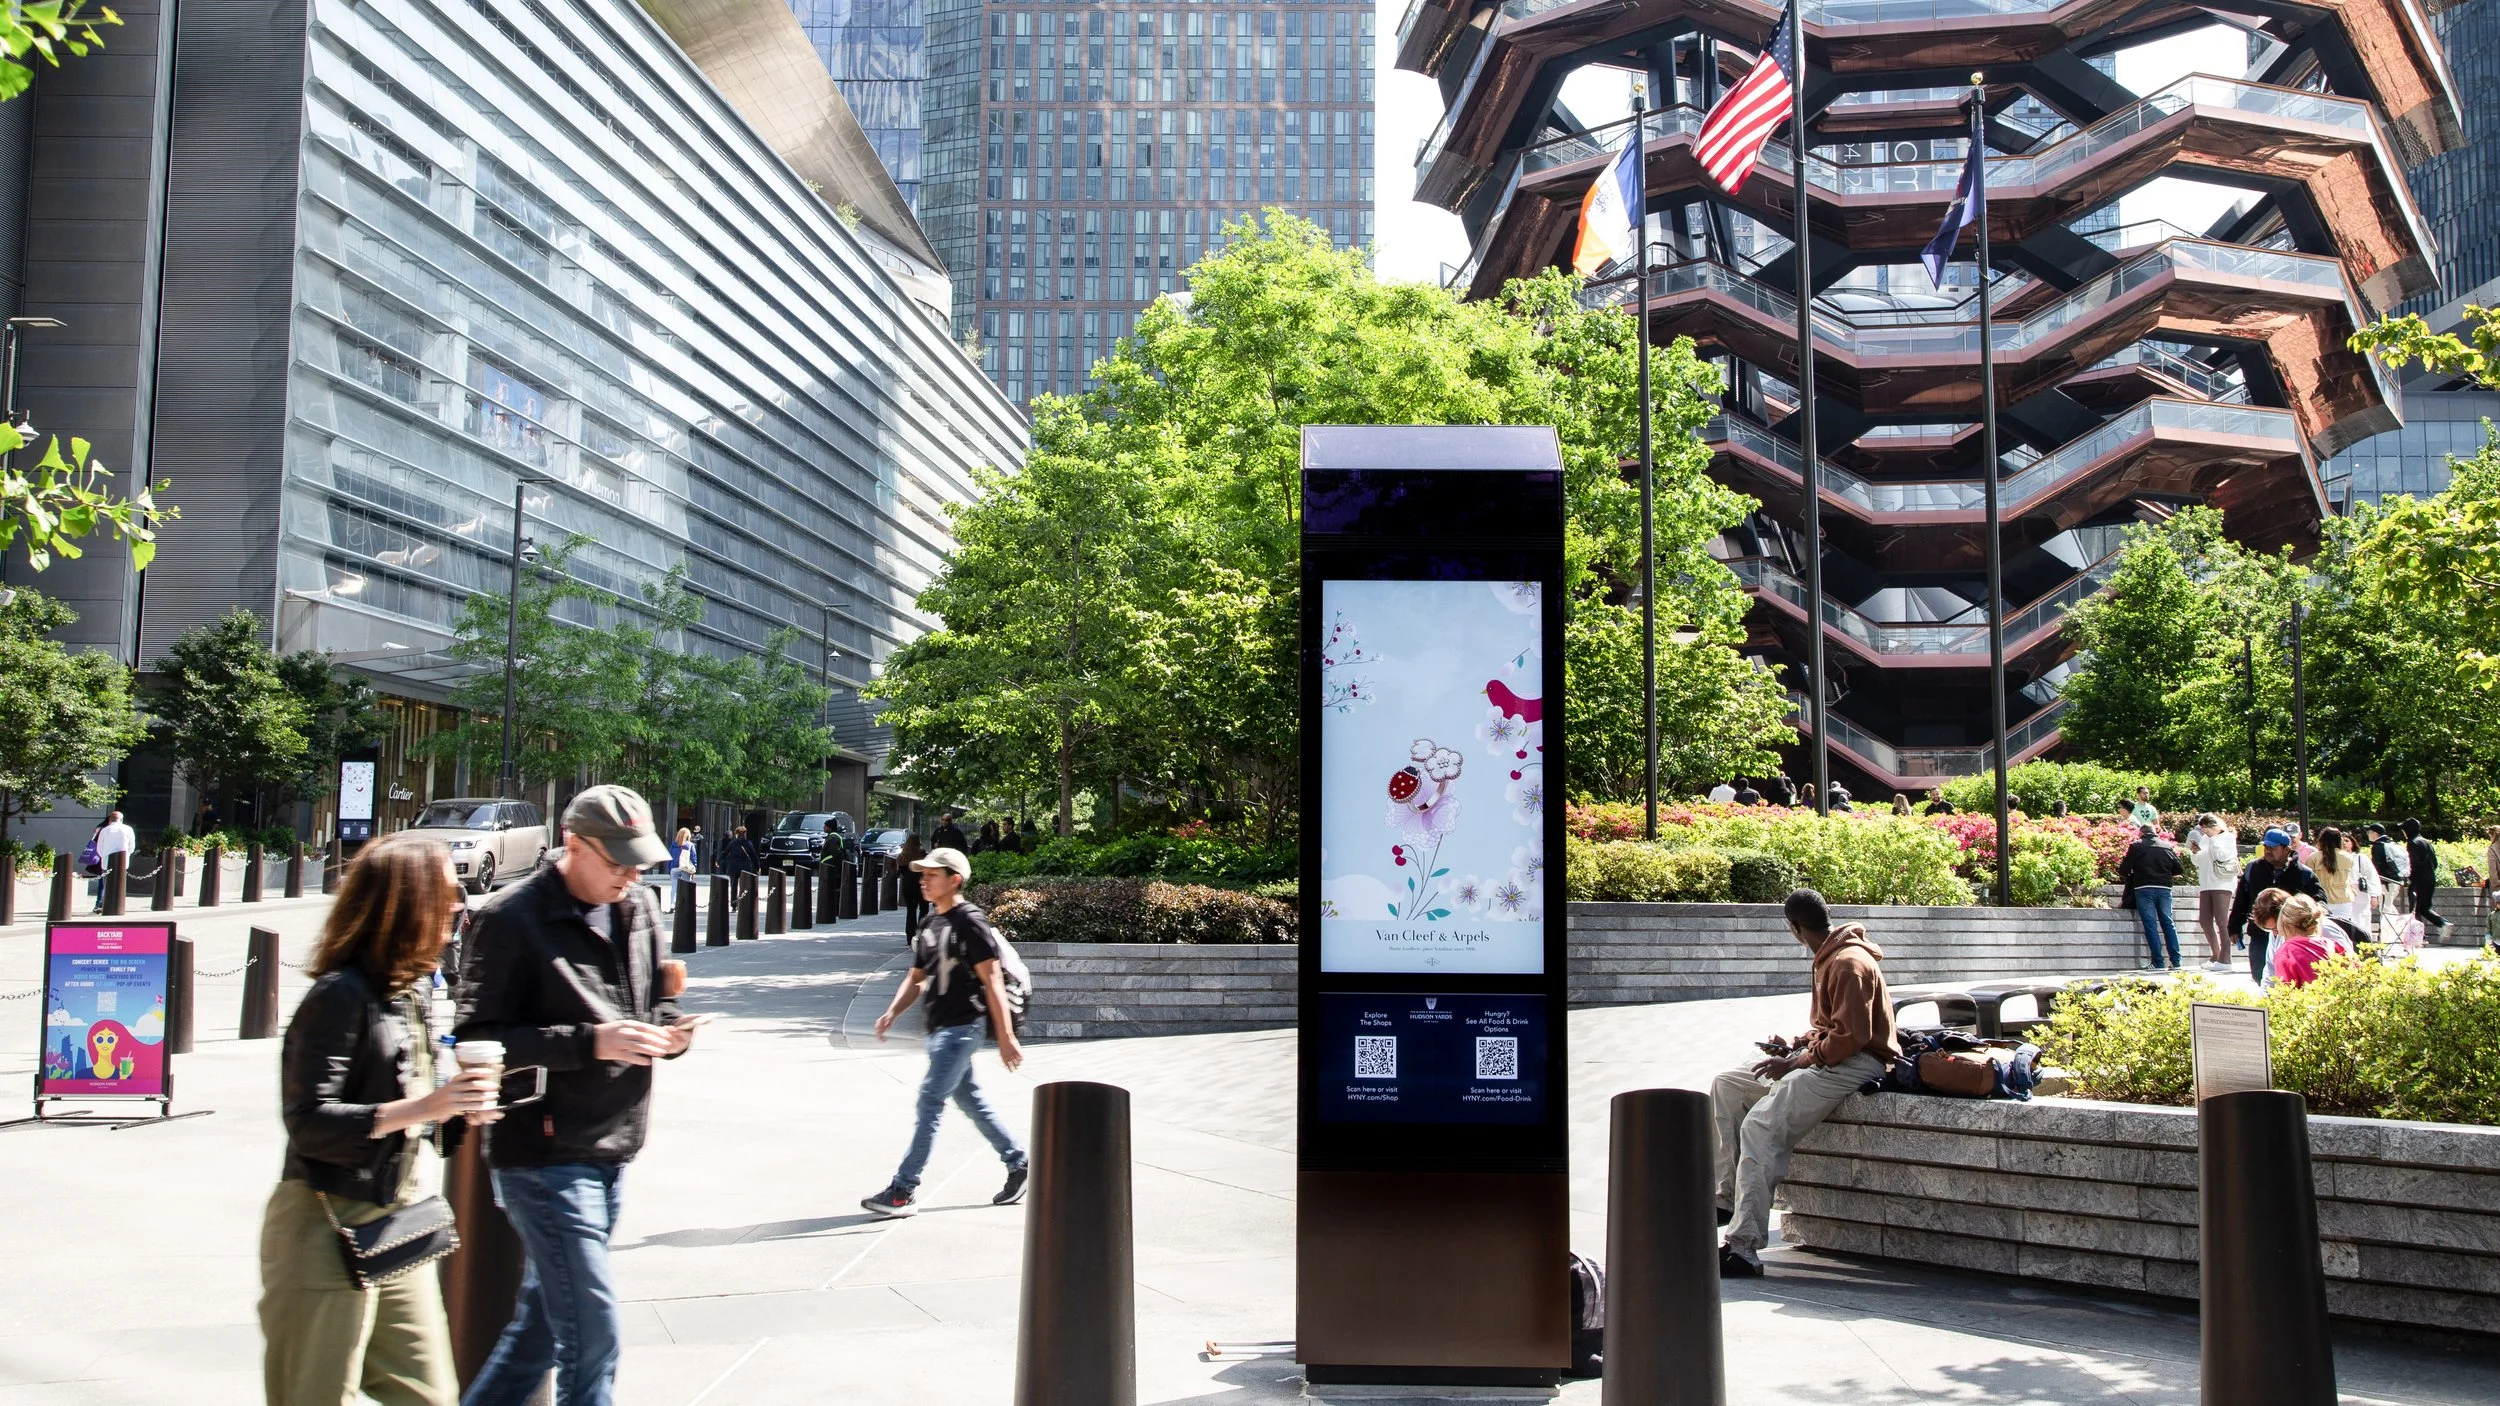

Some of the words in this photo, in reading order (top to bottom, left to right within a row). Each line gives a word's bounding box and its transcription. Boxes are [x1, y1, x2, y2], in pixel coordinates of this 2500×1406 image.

[388, 782, 414, 801] Cartier
[1376, 929, 1399, 941] Van
[1402, 929, 1436, 941] Cleef
[1438, 932, 1447, 942] &
[1451, 930, 1490, 945] Arpels
[1373, 1019, 1392, 1027] Shops
[1348, 1094, 1399, 1102] HYNY.com/Shop
